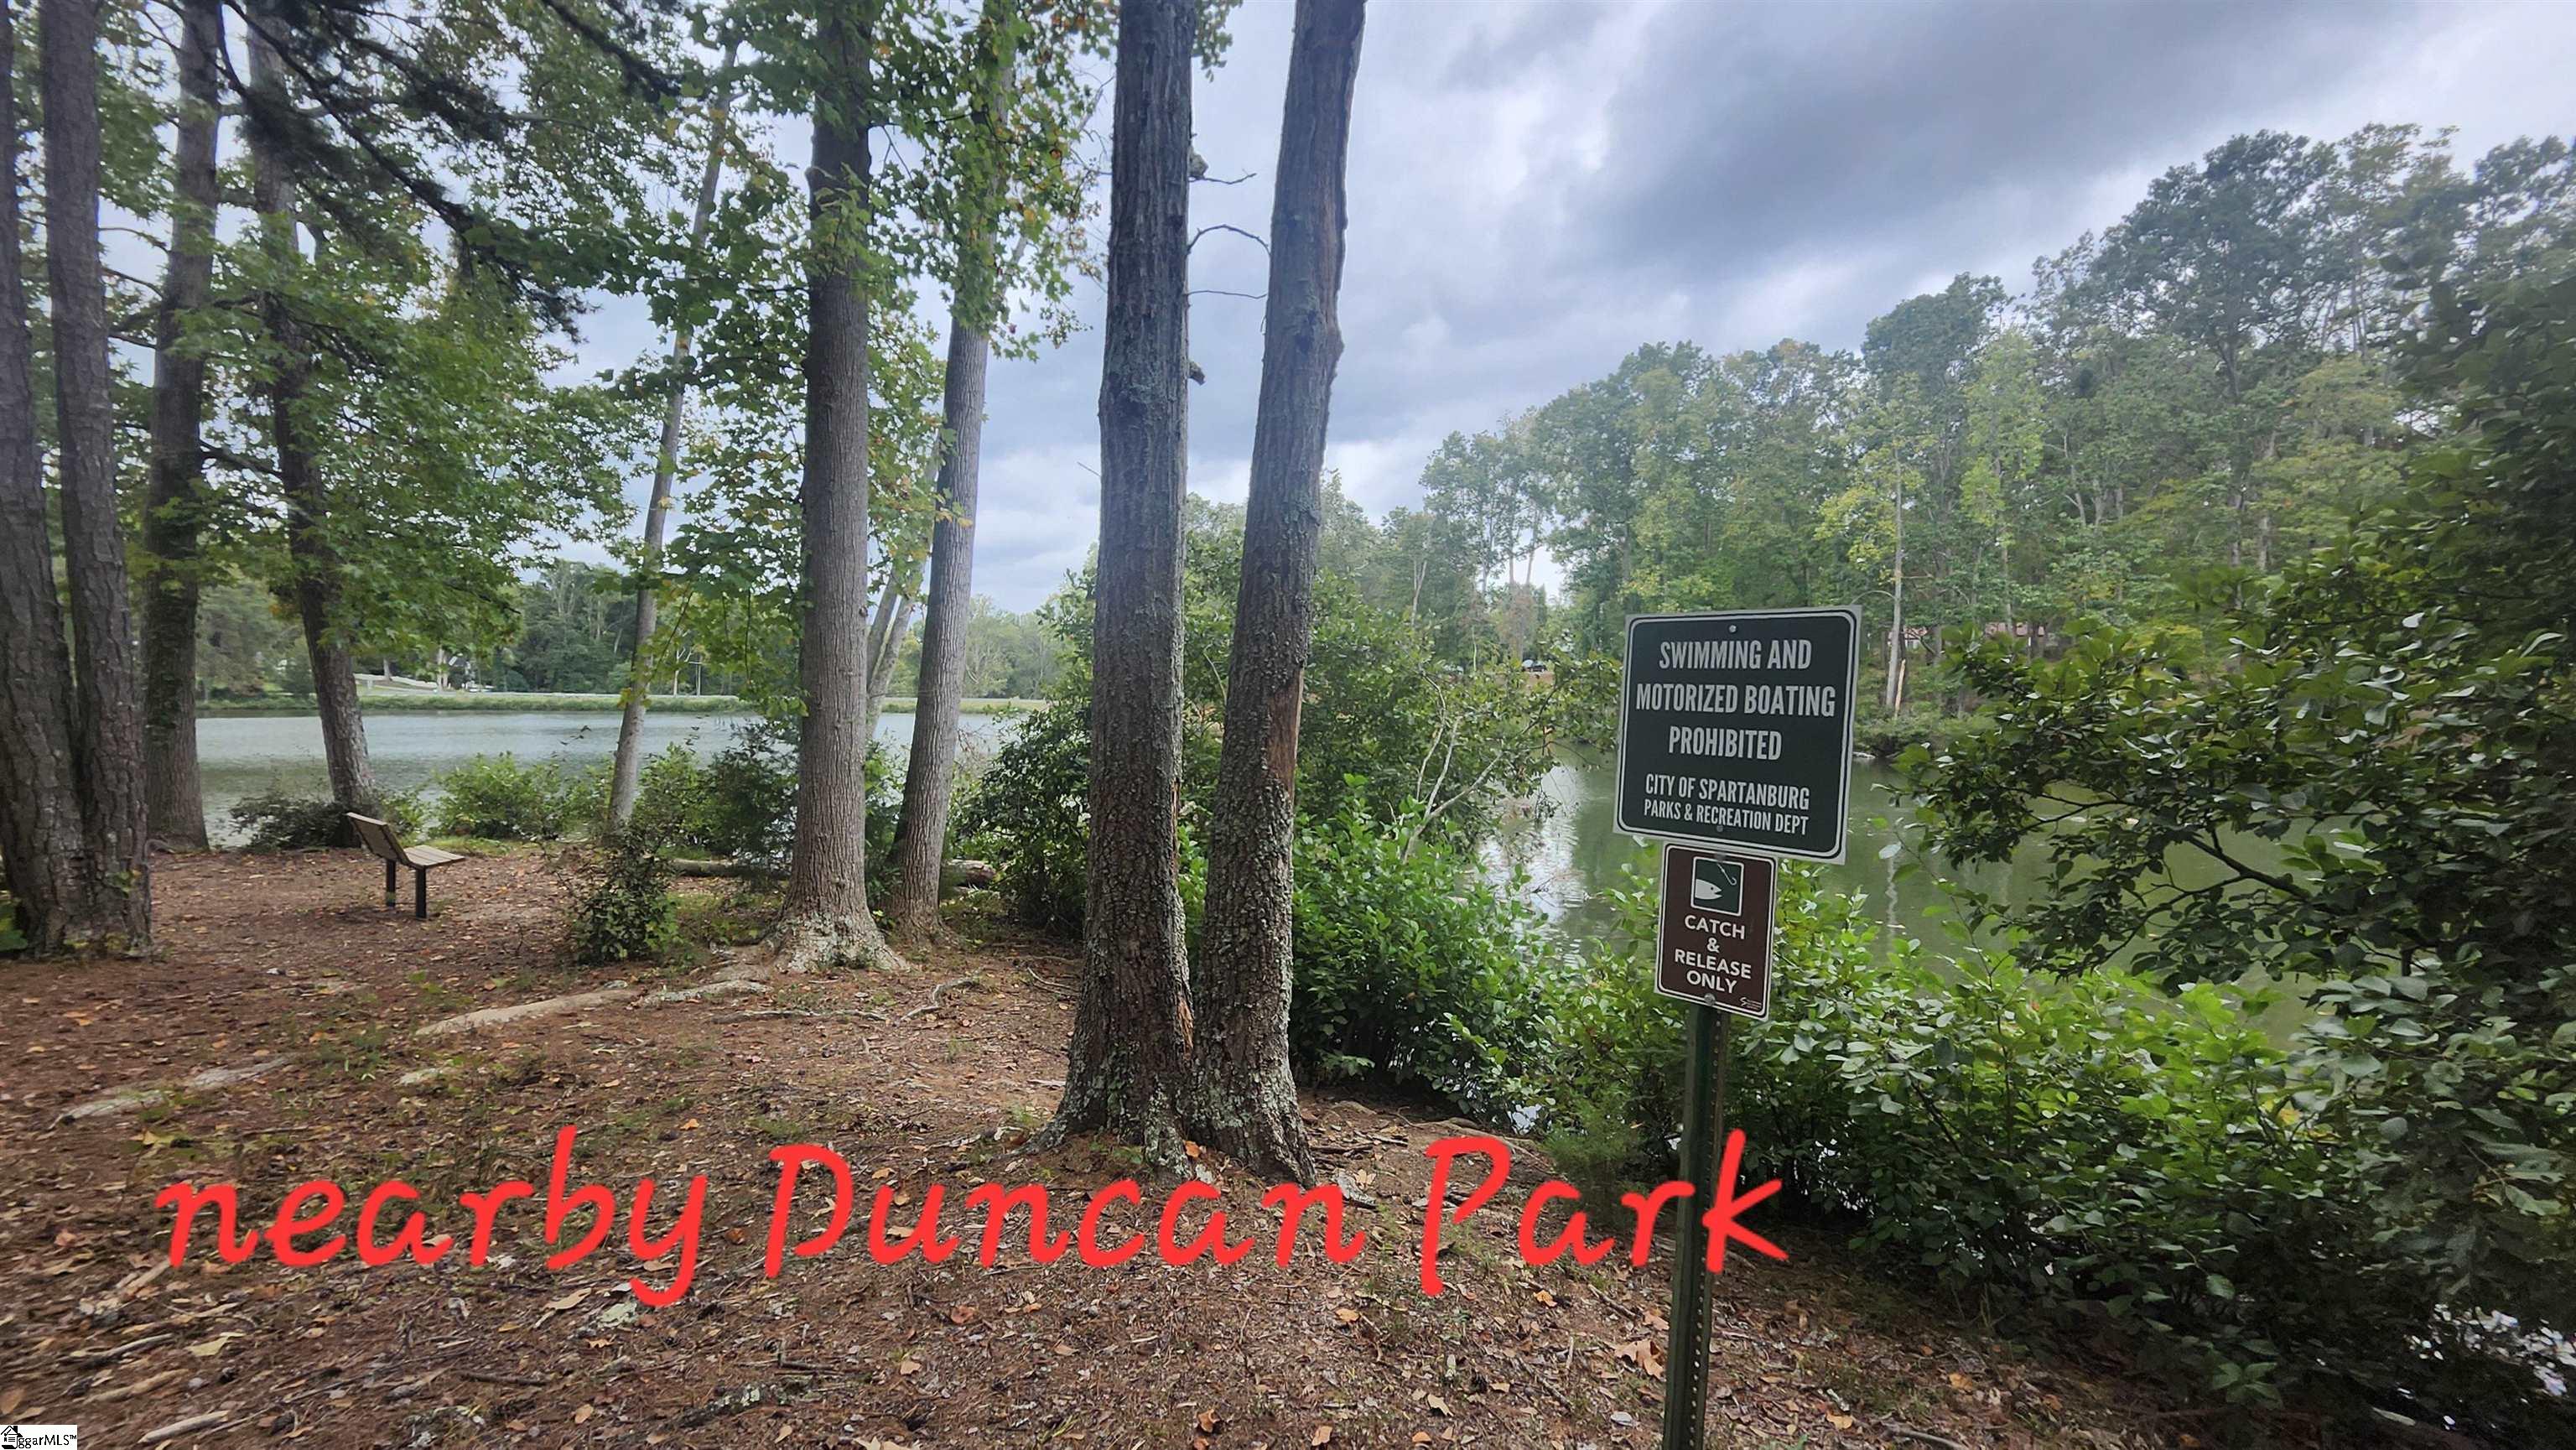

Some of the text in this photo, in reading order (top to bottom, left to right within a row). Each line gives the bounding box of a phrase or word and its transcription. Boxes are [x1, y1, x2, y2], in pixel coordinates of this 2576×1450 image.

[1659, 639, 1812, 669] SWIMMING AND
[1636, 683, 1836, 716] MOTORIZED BOATING
[1669, 725, 1782, 760] PROHIBITED
[1645, 773, 1810, 810] CITY OF SPARTANBURG
[1644, 798, 1809, 835] PARKS & RECREATION DEPT
[1684, 915, 1745, 939] CATCH
[1706, 938, 1720, 953] &
[1675, 948, 1752, 979] RELEASE
[1686, 970, 1737, 994] ONLY
